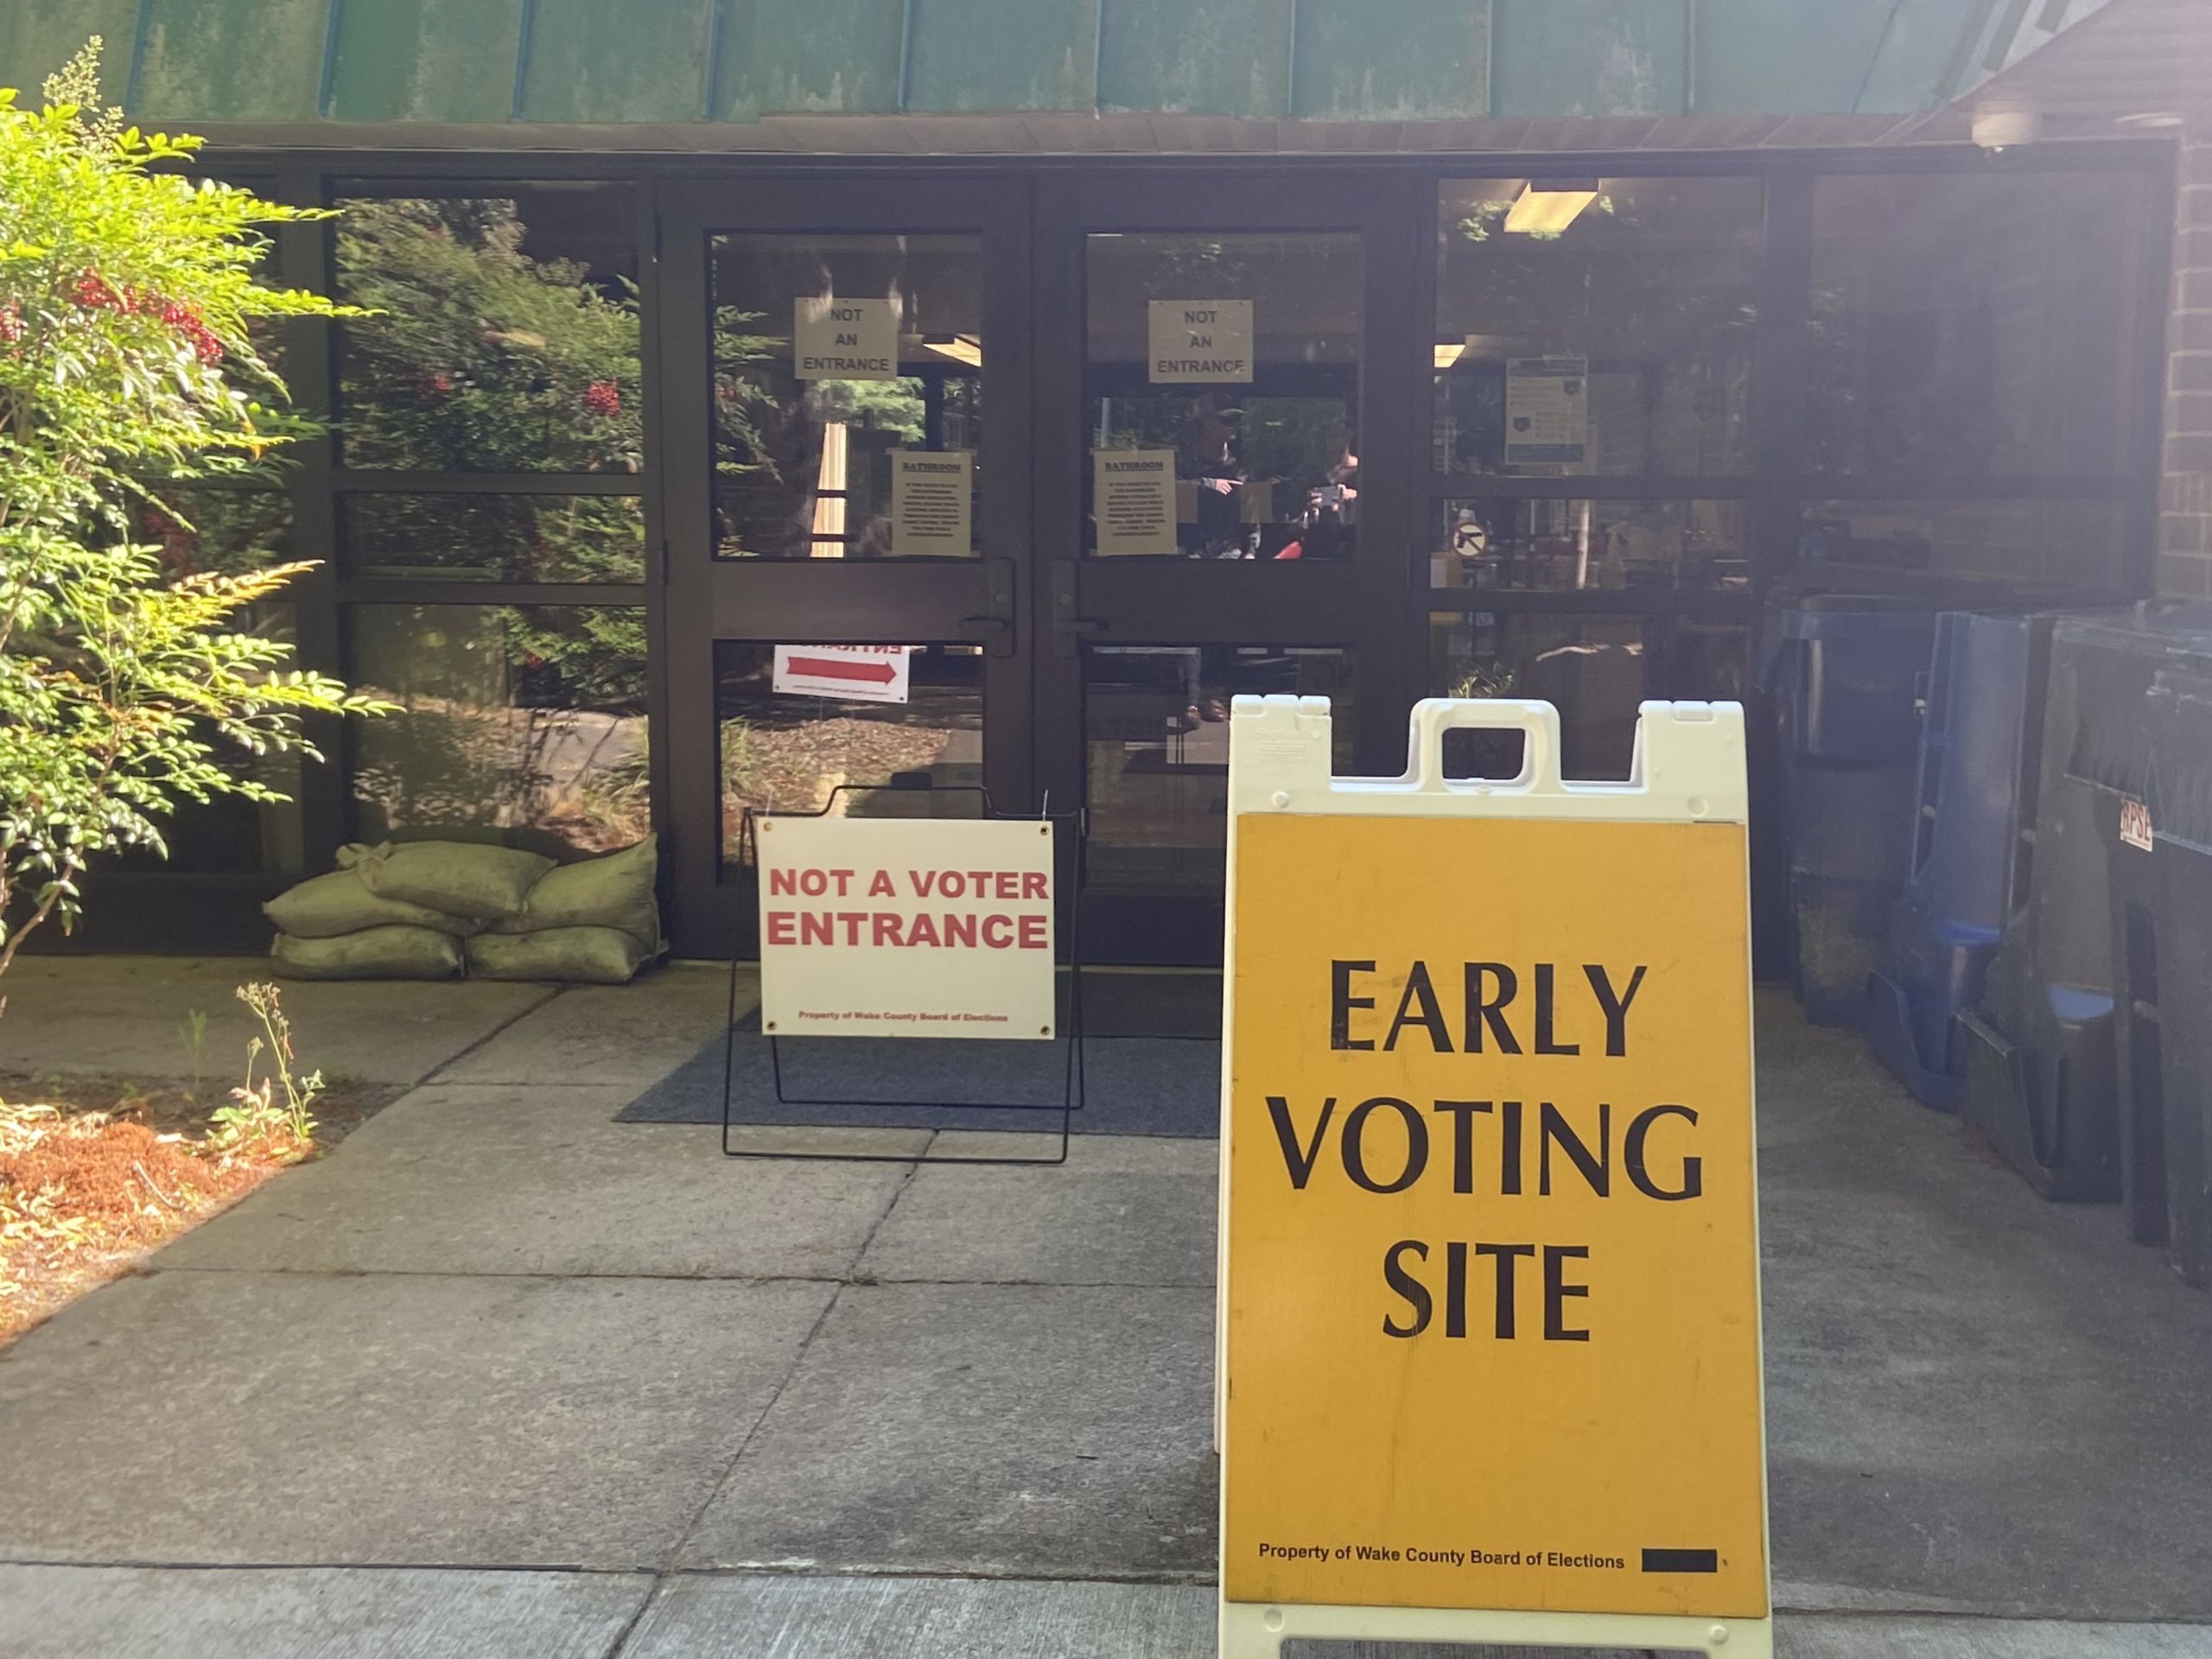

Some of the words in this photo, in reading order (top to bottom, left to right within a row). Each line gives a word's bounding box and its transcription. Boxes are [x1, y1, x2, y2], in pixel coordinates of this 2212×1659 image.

[830, 308, 863, 321] NOT
[1184, 310, 1217, 324] NOT
[835, 333, 858, 346] AN
[1189, 335, 1212, 348] AN
[803, 357, 889, 372] ENTRANCE
[1157, 359, 1245, 373] ENTRANCE
[902, 462, 961, 474] BATHROOM
[1105, 461, 1163, 472] BATHROOM
[770, 868, 855, 897] NOT
[868, 869, 896, 898] A
[908, 870, 1049, 899] VOTER
[767, 911, 1048, 950] ENTRANCE
[1330, 959, 1648, 1058] EARLY
[798, 1010, 840, 1021] Property
[842, 1011, 853, 1020] of
[854, 1011, 881, 1020] Wake
[883, 1012, 918, 1023] County
[919, 1012, 950, 1021] Board
[950, 1013, 962, 1021] of
[963, 1013, 1009, 1022] Elections
[1265, 1096, 1702, 1201] VOTING
[1382, 1239, 1590, 1342] SITE
[1259, 1542, 1330, 1563] Property
[1334, 1545, 1351, 1560] of
[1355, 1545, 1401, 1561] Wake
[1405, 1548, 1465, 1567] County
[1470, 1549, 1521, 1566] Board
[1525, 1551, 1543, 1567] of
[1547, 1552, 1625, 1569] Elections
